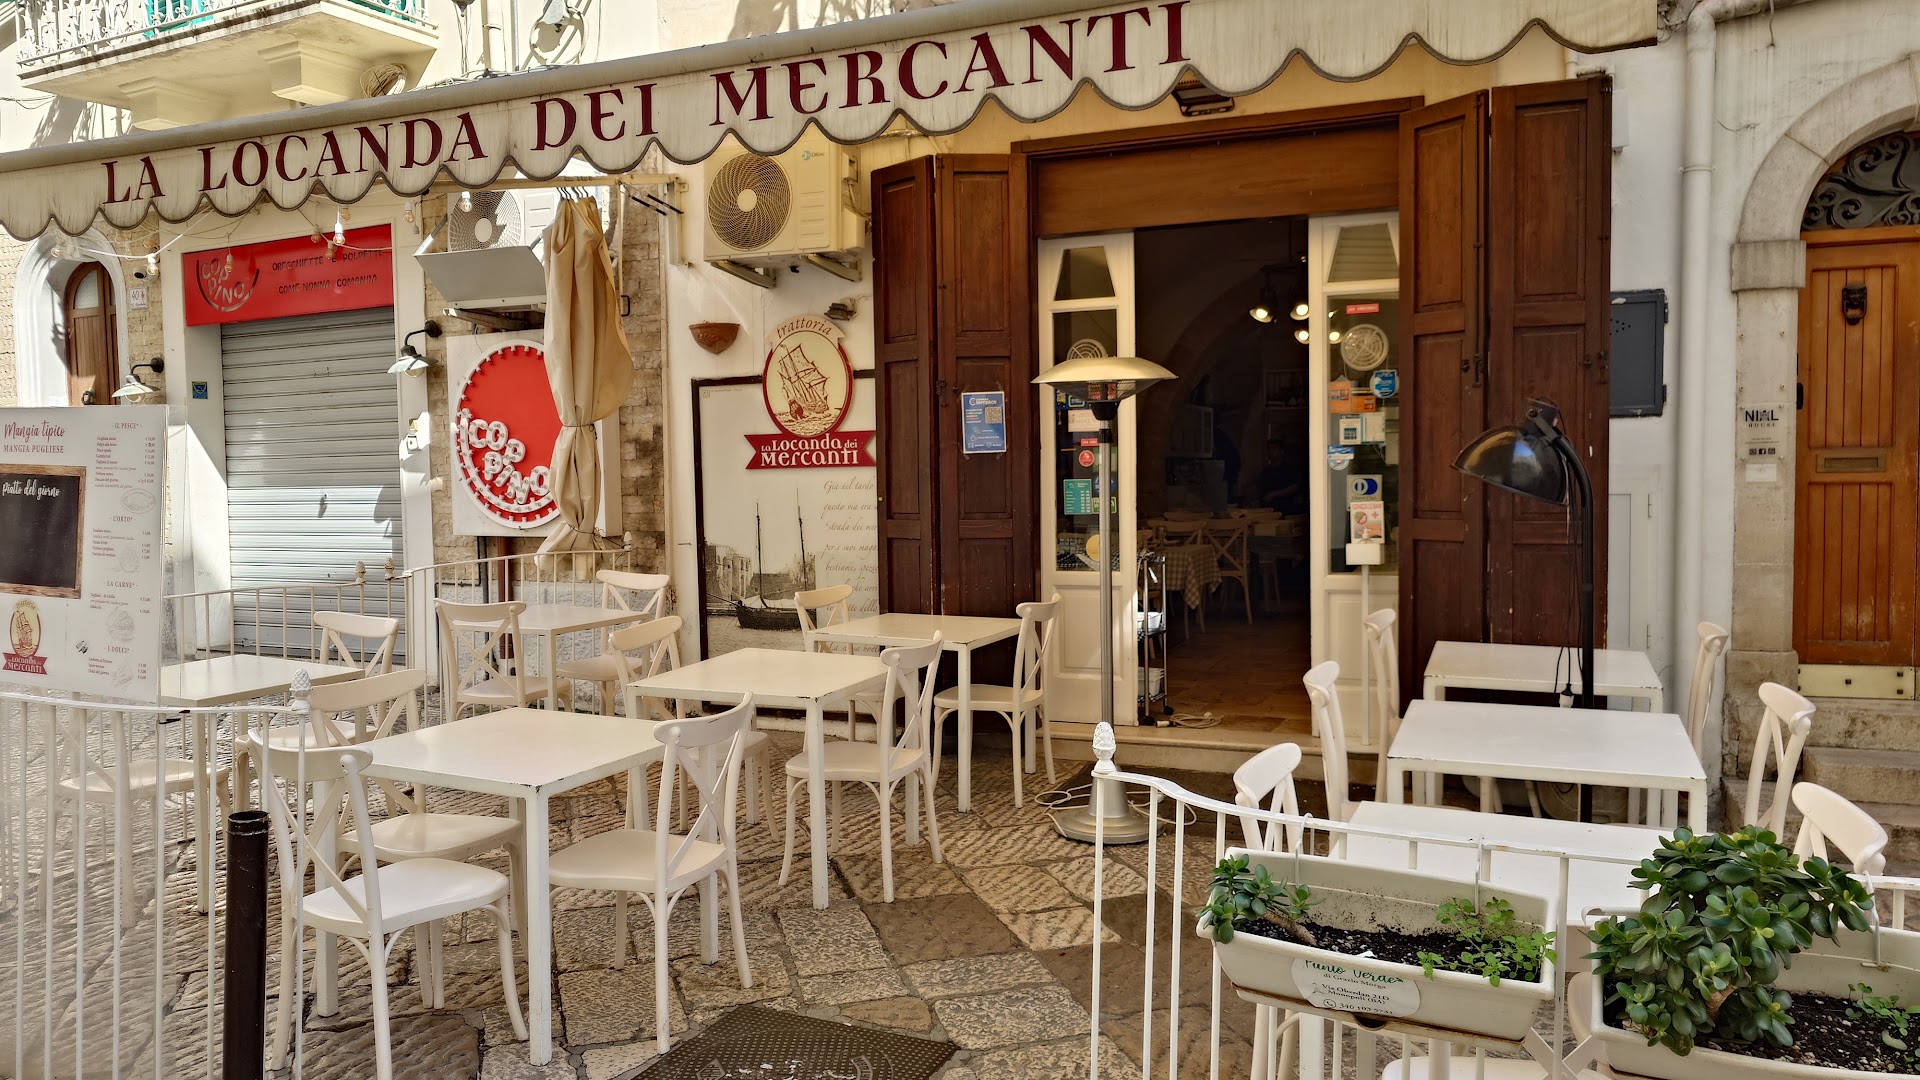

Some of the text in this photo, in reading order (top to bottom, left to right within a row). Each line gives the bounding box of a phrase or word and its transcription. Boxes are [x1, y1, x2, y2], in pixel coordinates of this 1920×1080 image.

[102, 1, 1192, 205] LA LOCANDA DEI MERCANTI
[272, 256, 323, 271] ORECCHIETTE
[342, 250, 384, 262] POLPETTE
[278, 274, 378, 294] COME NONNA COMANDA
[777, 317, 832, 340] trattoria
[4, 420, 66, 443] Mangia tipico
[3, 444, 65, 454] MANGIA PUGLIESE
[772, 433, 843, 451] Locanda
[844, 439, 858, 449] dei
[760, 447, 860, 467] Mercanti
[2, 479, 61, 501] Piatto del giorno
[840, 475, 857, 490] nel
[7, 662, 42, 673] Mercanti
[1321, 983, 1336, 991] Via
